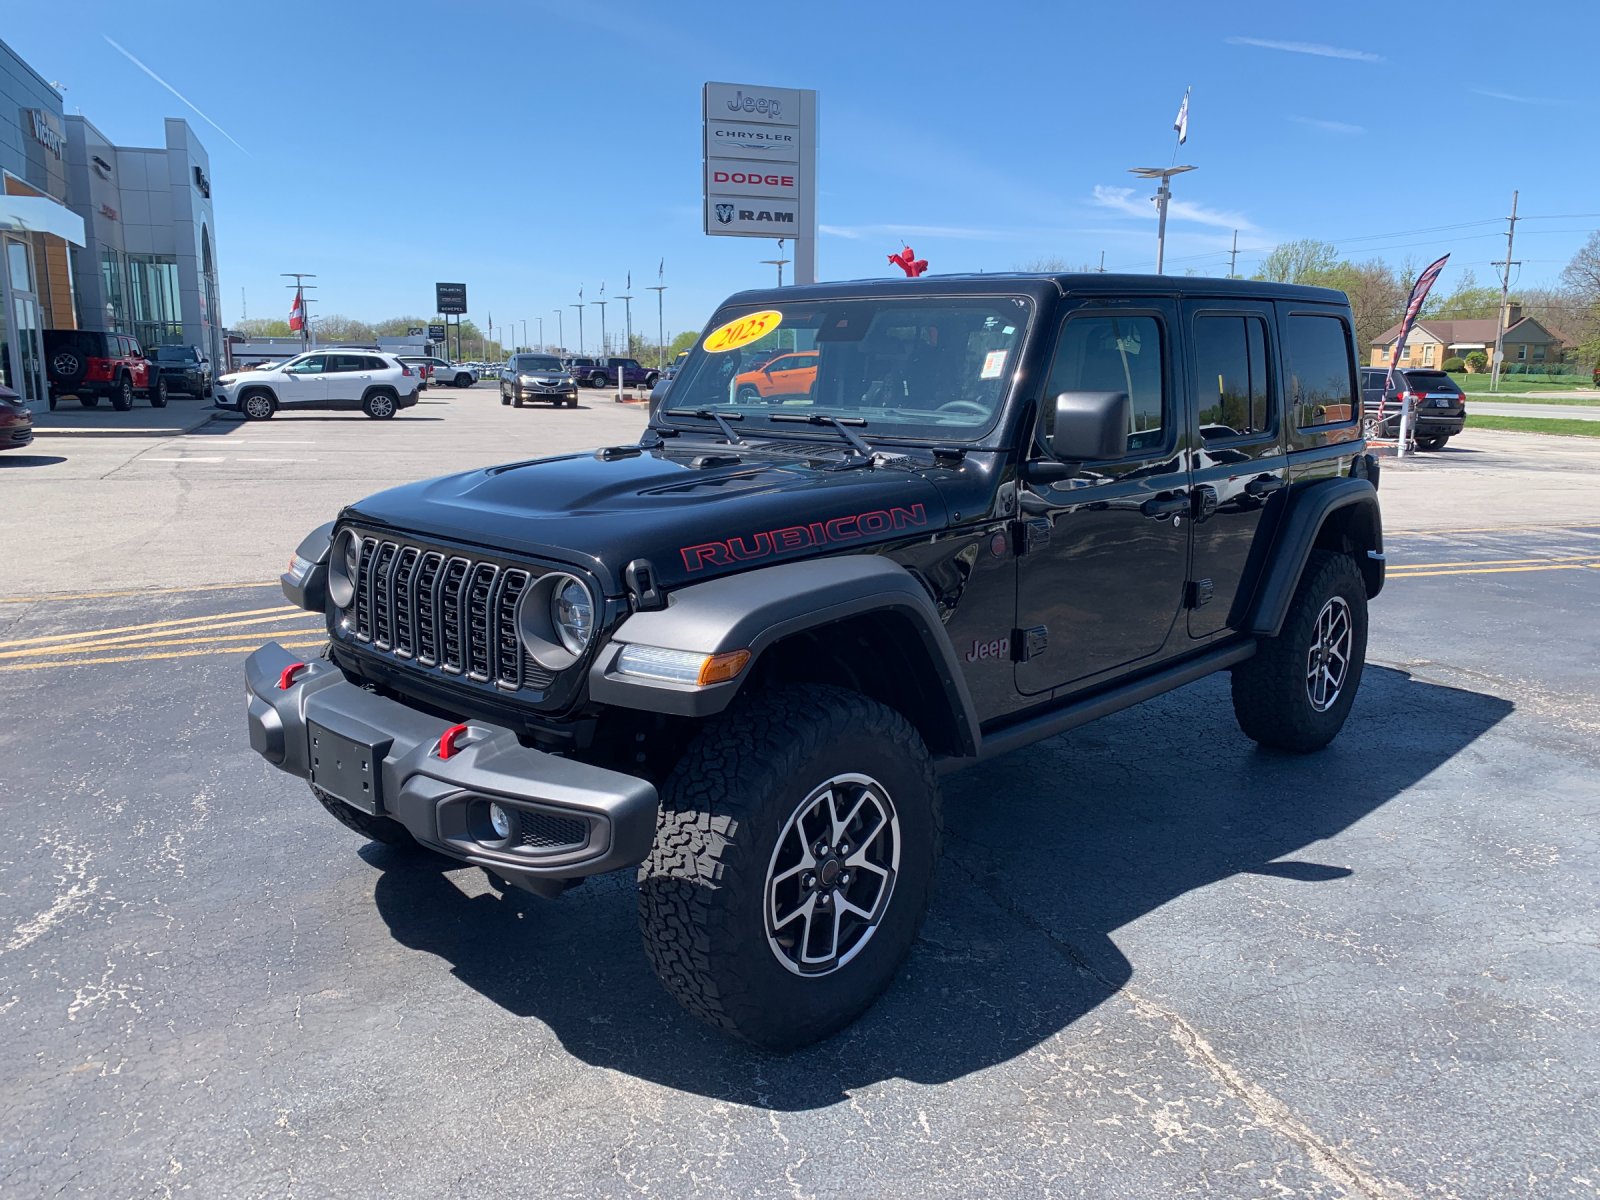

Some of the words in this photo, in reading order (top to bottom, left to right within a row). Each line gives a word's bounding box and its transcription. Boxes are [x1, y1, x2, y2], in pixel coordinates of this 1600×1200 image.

[727, 91, 782, 119] Jeep
[715, 130, 792, 141] CHRYSLER
[714, 171, 794, 187] DODGE
[739, 210, 793, 222] RAM
[714, 314, 770, 349] 2025
[680, 504, 927, 572] RUBICON
[966, 638, 1009, 663] Jeep
